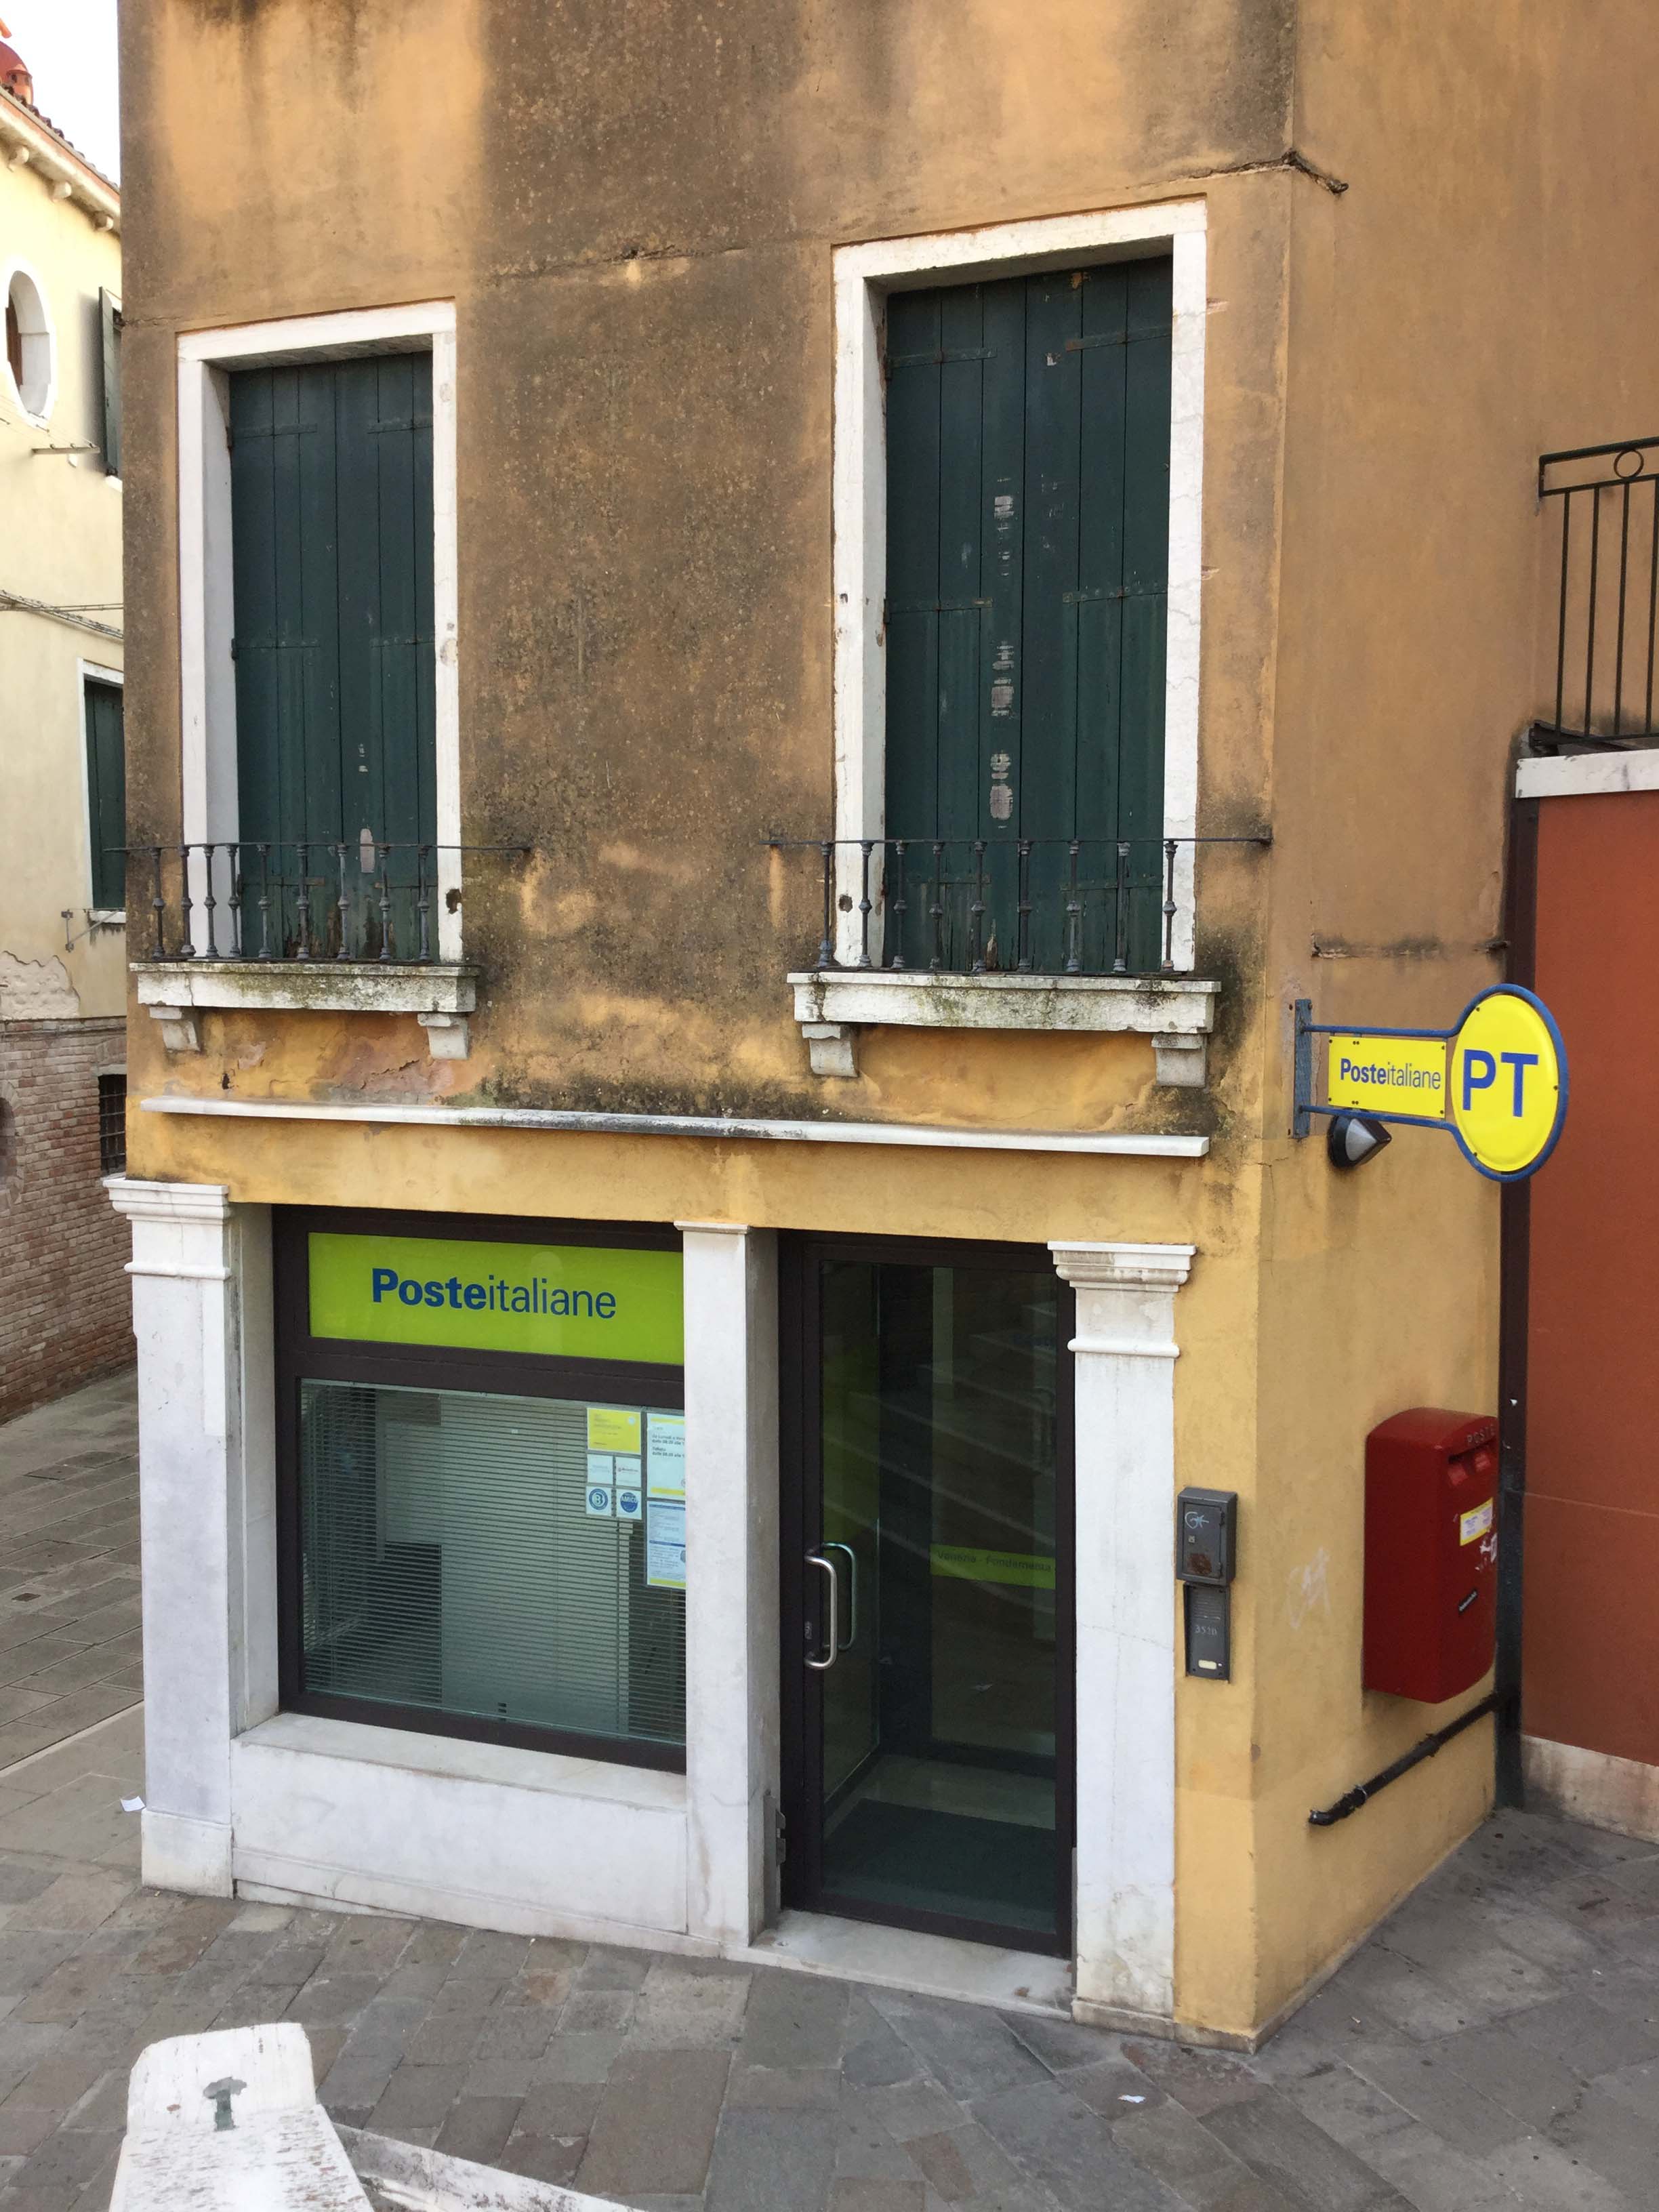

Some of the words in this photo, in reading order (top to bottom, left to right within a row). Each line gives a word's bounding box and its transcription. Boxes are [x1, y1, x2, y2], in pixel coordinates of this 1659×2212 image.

[1340, 1057, 1441, 1089] Posteitaliane
[1462, 1048, 1539, 1118] PT
[371, 1267, 617, 1319] Posteitaliane
